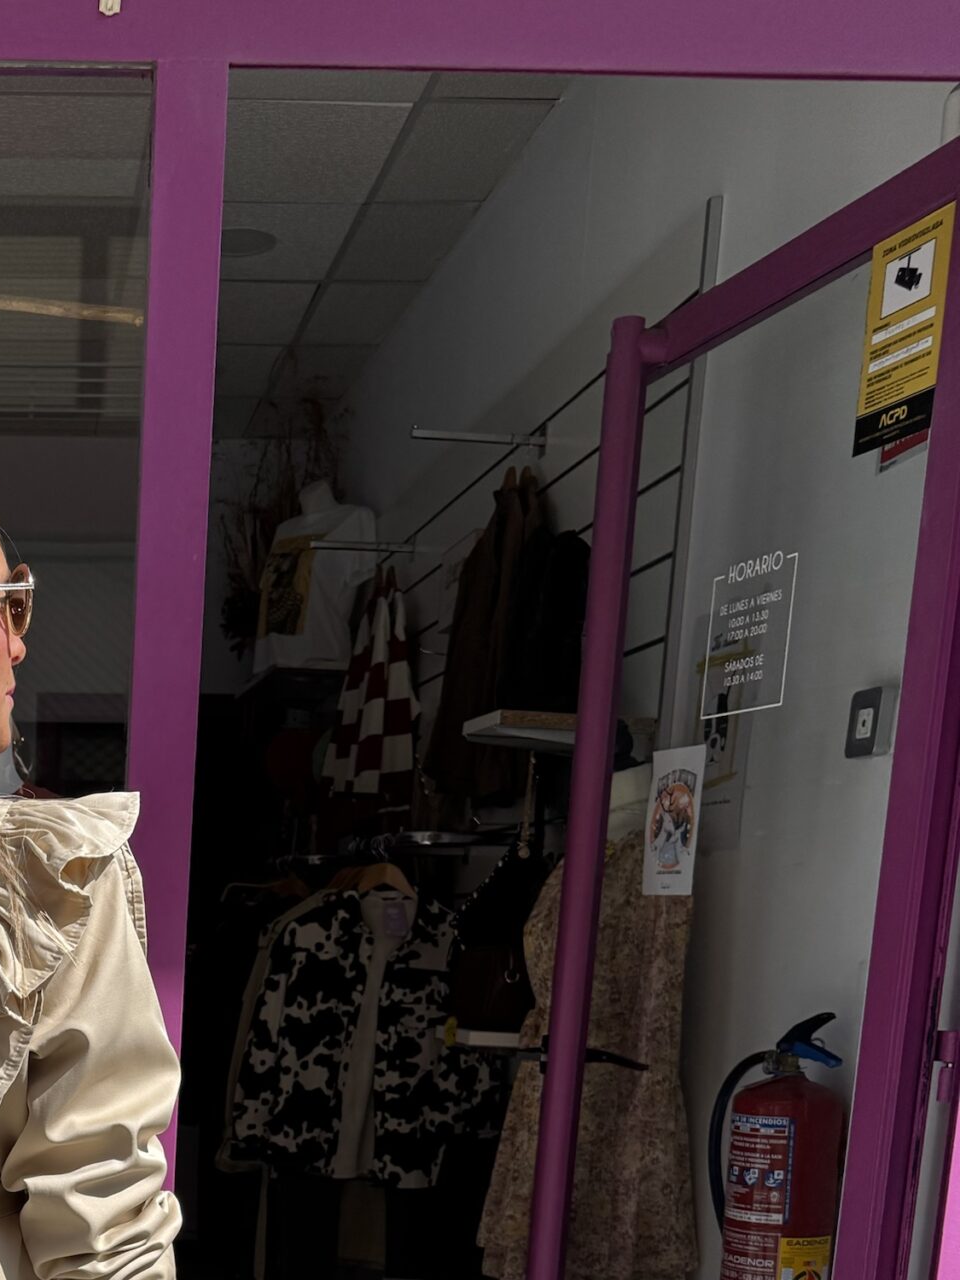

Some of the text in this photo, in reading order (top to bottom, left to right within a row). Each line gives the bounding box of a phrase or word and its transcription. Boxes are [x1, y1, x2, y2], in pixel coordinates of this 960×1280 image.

[878, 405, 908, 429] ACPD
[728, 550, 784, 584] HORARIO
[720, 589, 783, 616] DE LUNES A VIERNES
[745, 615, 750, 624] A
[744, 628, 749, 638] A
[755, 653, 764, 666] DE
[740, 674, 745, 683] A
[748, 1117, 787, 1126] INCENDIOS
